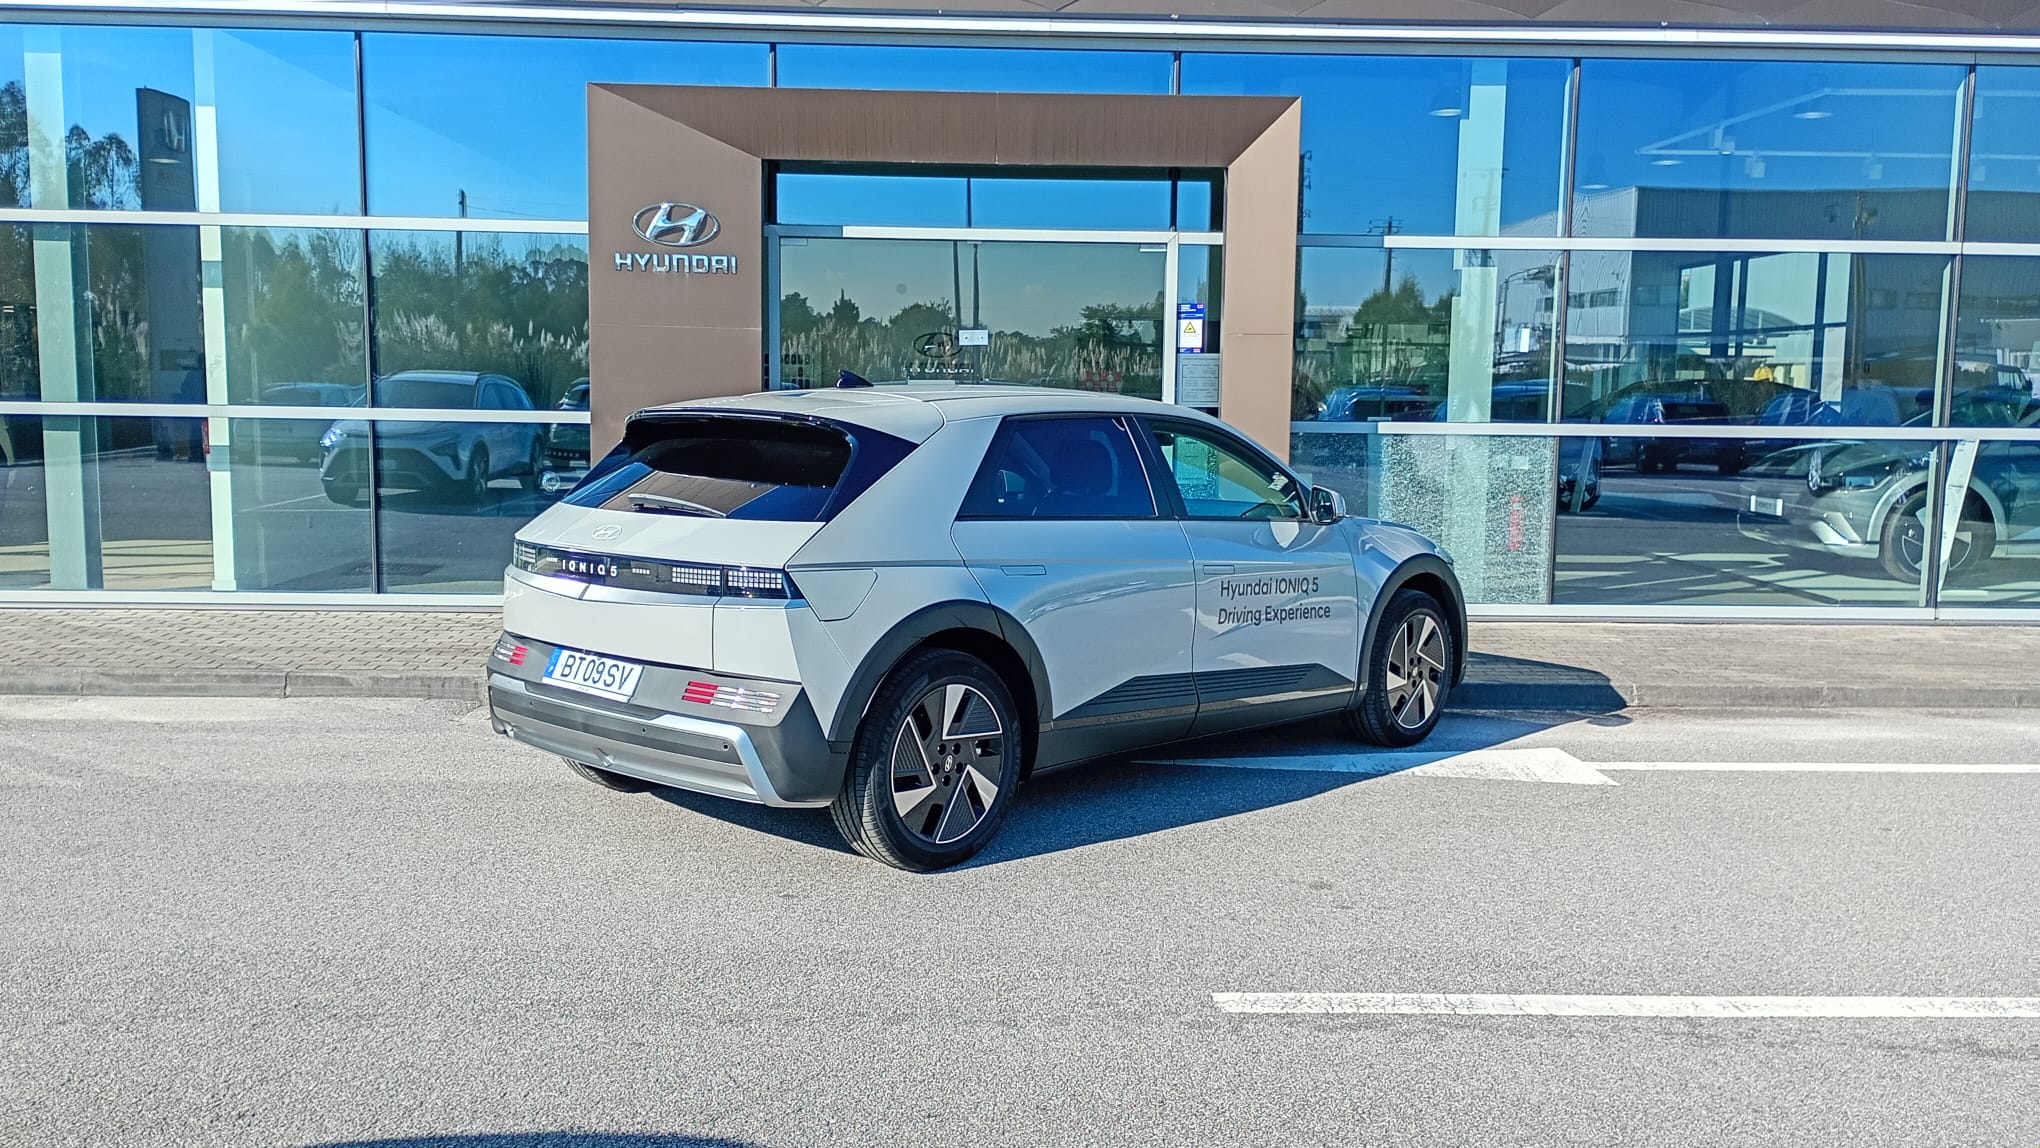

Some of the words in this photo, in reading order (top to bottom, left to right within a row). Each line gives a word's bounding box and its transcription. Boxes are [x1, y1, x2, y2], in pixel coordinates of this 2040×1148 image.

[614, 251, 737, 274] HYUNDAI
[562, 560, 606, 576] IONIQ
[610, 565, 618, 577] 5
[1220, 577, 1273, 601] Hyundai
[1274, 577, 1310, 596] IONIQ
[1311, 577, 1319, 593] 5
[1217, 605, 1262, 626] Driving
[1264, 602, 1331, 624] Experience
[560, 654, 634, 690] BT09SV
